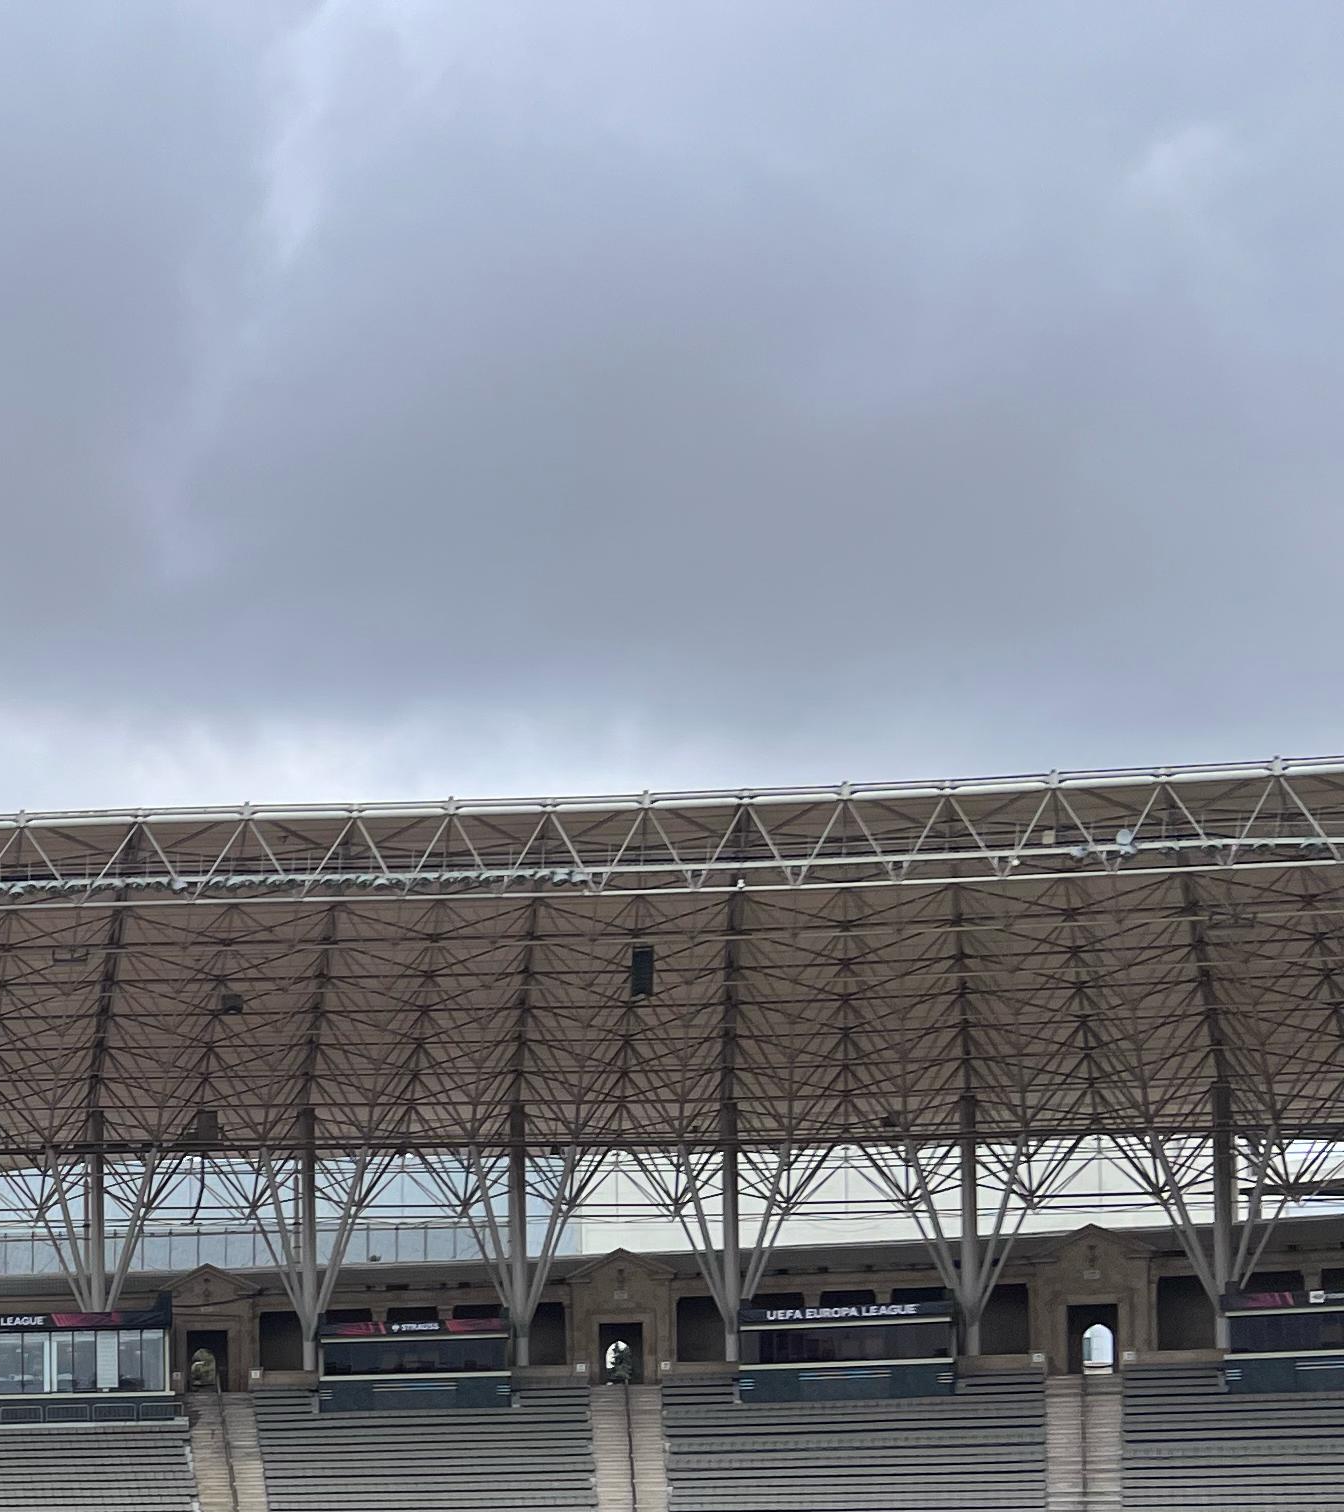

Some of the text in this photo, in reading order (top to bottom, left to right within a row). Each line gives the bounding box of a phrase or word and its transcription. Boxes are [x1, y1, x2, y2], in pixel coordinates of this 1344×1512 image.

[766, 1304, 918, 1320] UEFA EUROPA LEAGUE
[0, 1316, 45, 1326] LEAGUE
